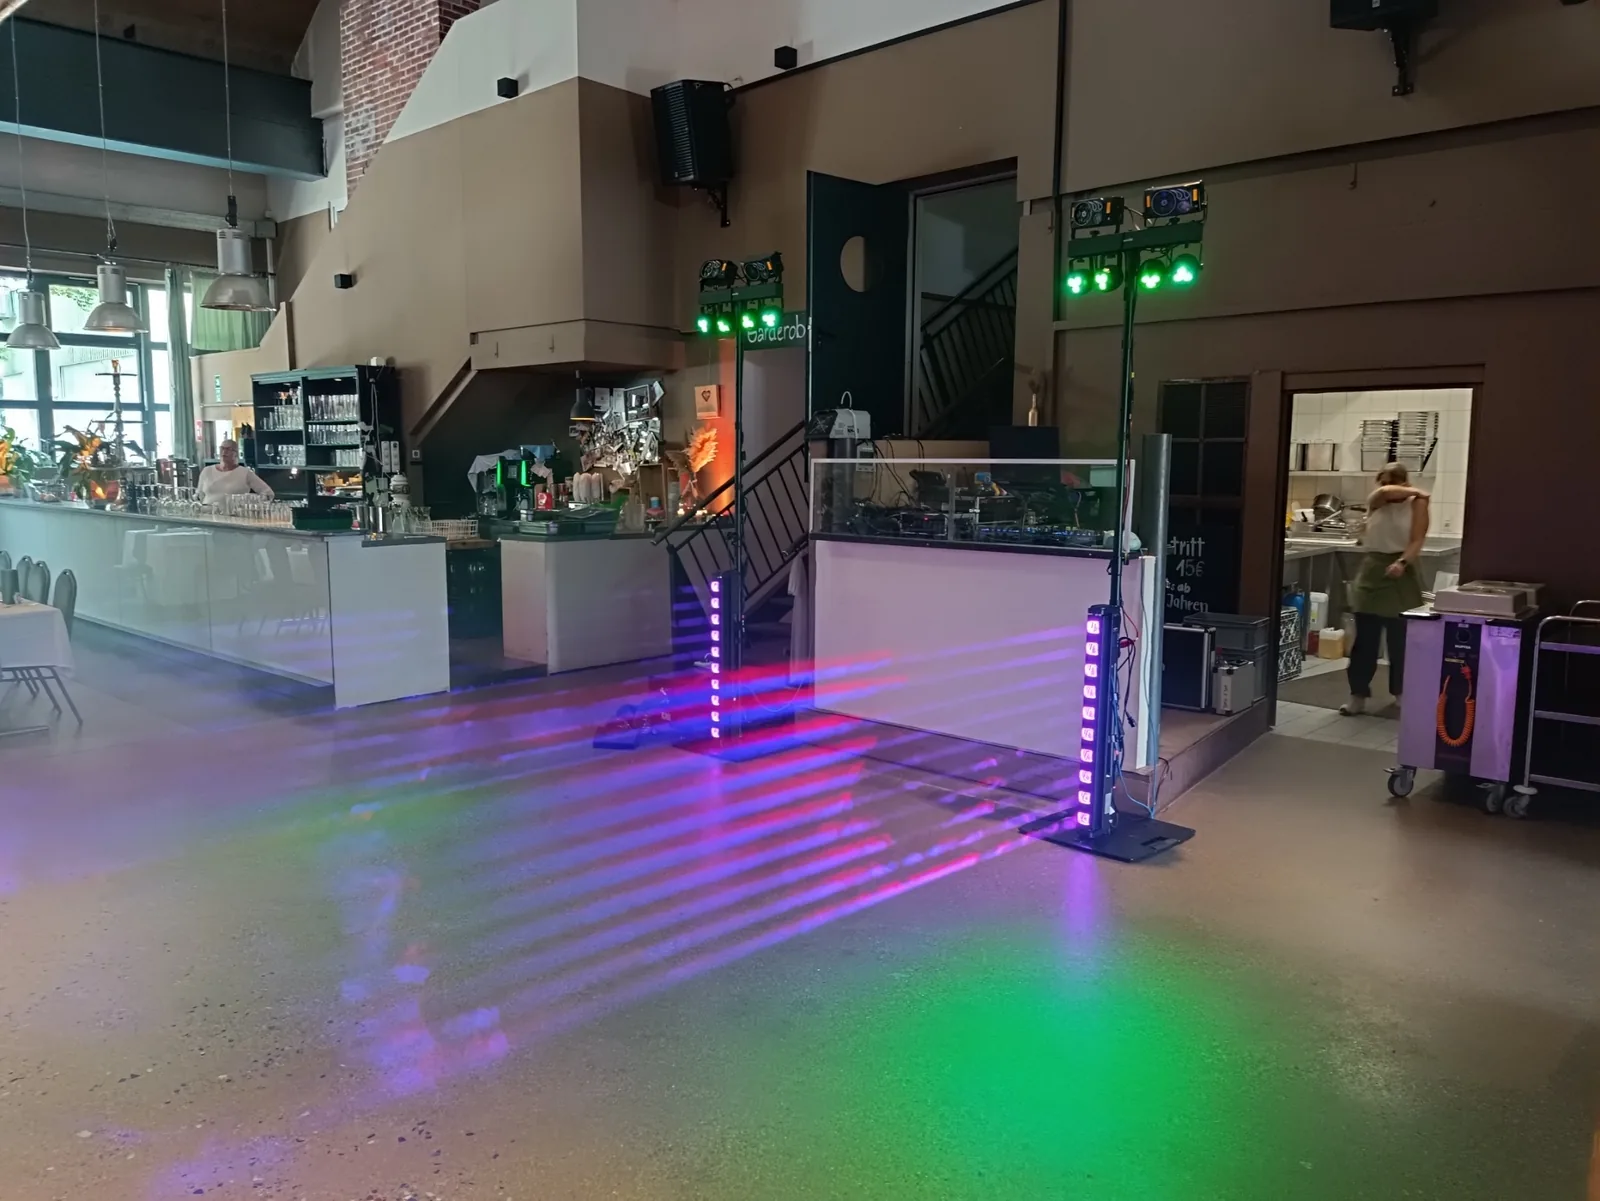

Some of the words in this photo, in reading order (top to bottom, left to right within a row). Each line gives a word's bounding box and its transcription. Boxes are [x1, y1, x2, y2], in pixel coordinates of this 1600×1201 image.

[747, 314, 806, 343] Garderob
[1170, 536, 1206, 557] tritt
[1177, 582, 1191, 594] ab
[1166, 593, 1209, 613] Jahren
